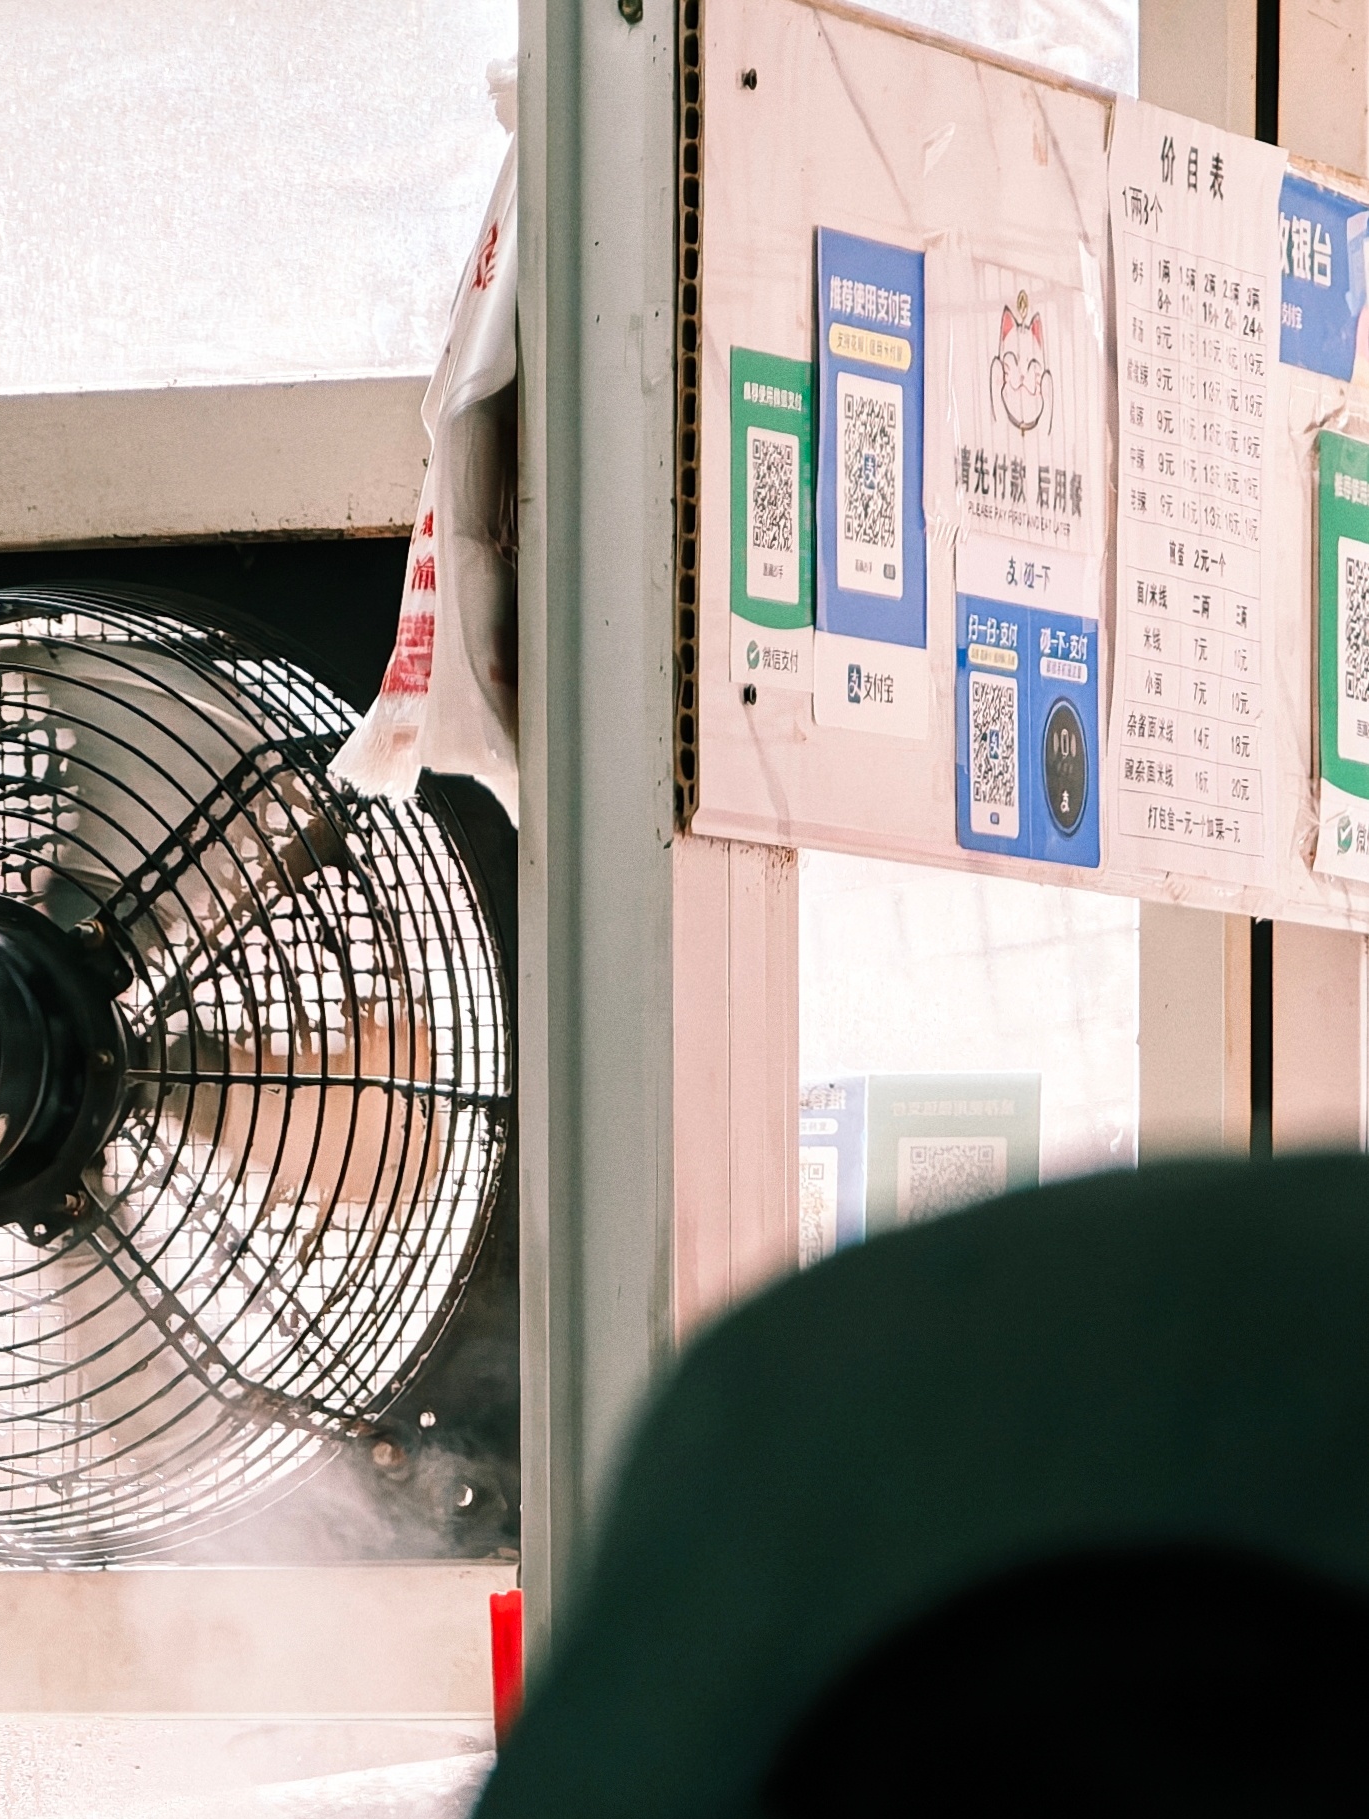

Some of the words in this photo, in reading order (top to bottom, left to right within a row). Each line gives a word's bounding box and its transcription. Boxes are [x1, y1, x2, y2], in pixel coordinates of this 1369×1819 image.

[1161, 135, 1224, 201] 价目表
[829, 274, 912, 328] 推荐使用支付宝
[1243, 314, 1264, 341] 24个
[1157, 409, 1174, 435] 9元
[1157, 452, 1175, 477] 9元
[954, 445, 1026, 504] 请先付款
[1036, 465, 1083, 518] 后用餐
[968, 501, 993, 520] PLEASE
[1193, 549, 1227, 578] 2元一个
[1192, 594, 1212, 620] 二两
[762, 646, 799, 674] 微信支付
[1194, 638, 1208, 662] 7元
[863, 674, 894, 705] 支付宝
[1193, 681, 1208, 706] 7元
